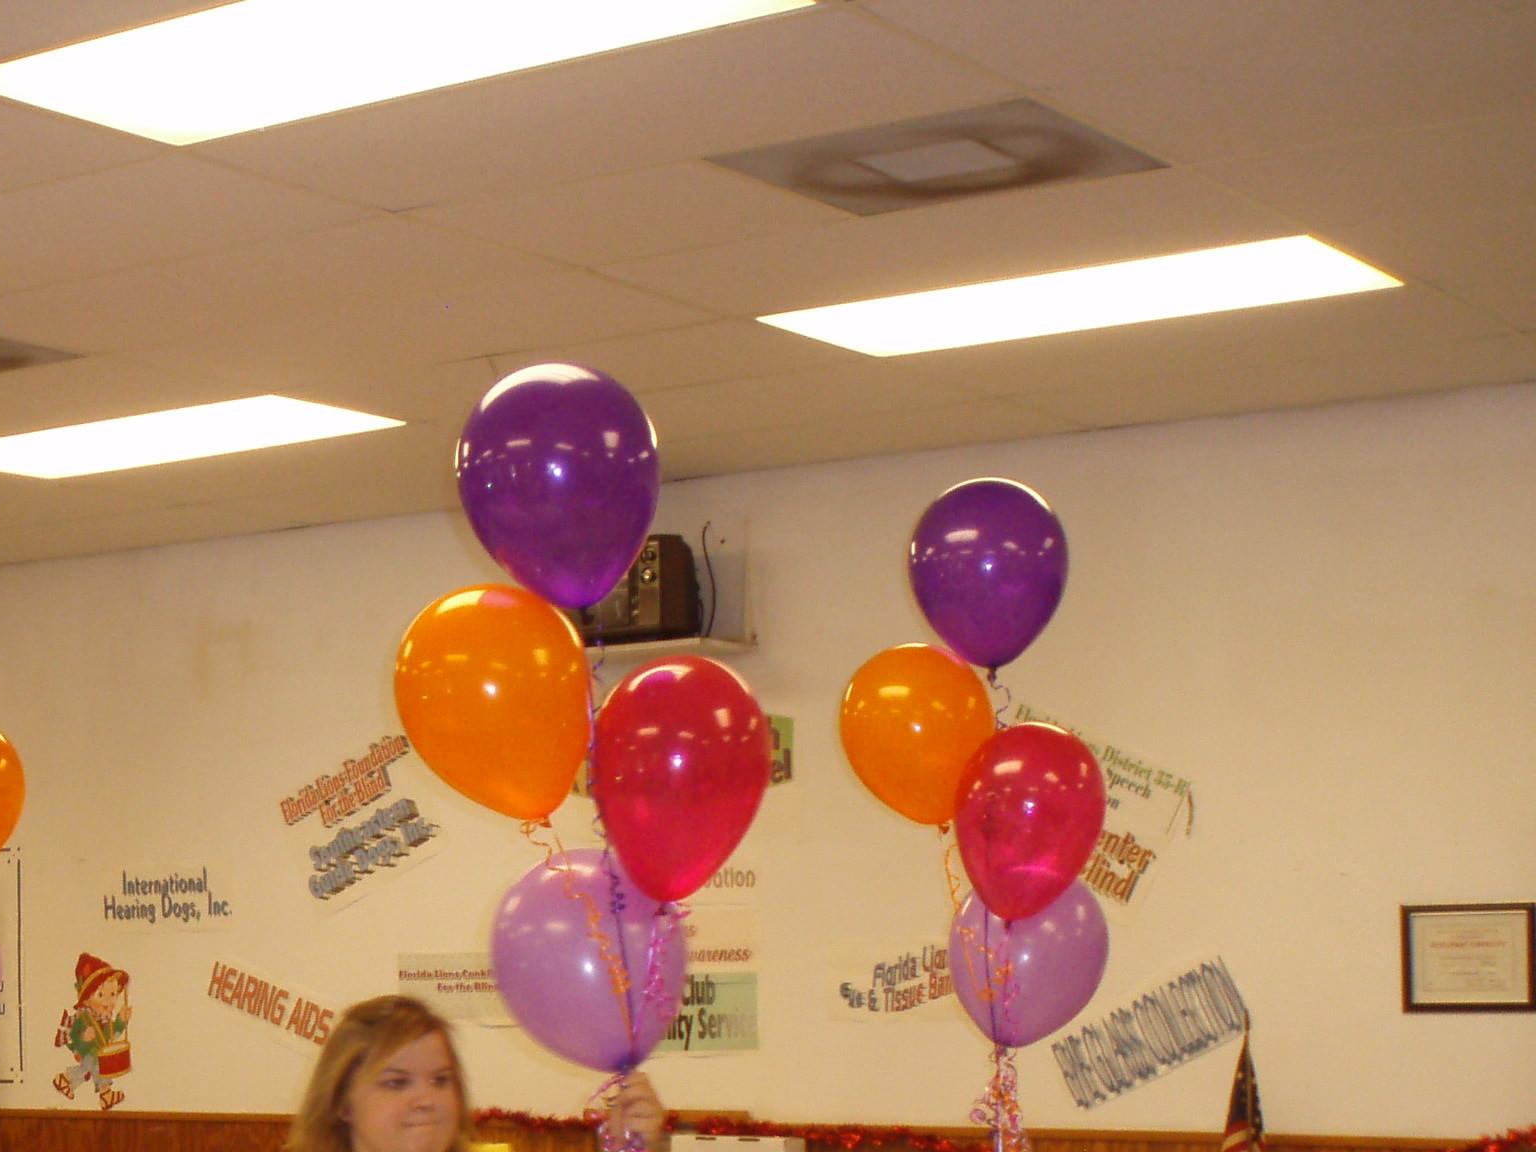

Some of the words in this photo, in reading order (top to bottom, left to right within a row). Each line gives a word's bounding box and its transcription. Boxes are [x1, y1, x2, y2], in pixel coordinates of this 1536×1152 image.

[280, 784, 322, 826] Florida
[343, 735, 411, 783] Foundation
[354, 765, 392, 807] Blind
[122, 866, 208, 896] International
[104, 895, 156, 924] Hearing
[161, 895, 202, 923] Dogs,
[207, 892, 232, 917] Inc.
[398, 969, 433, 981] Florida
[872, 951, 921, 988] Florida
[208, 961, 289, 1026] HEARING
[286, 997, 334, 1045] AIDS
[883, 983, 928, 1012] Tissue
[928, 971, 954, 1000] Ban
